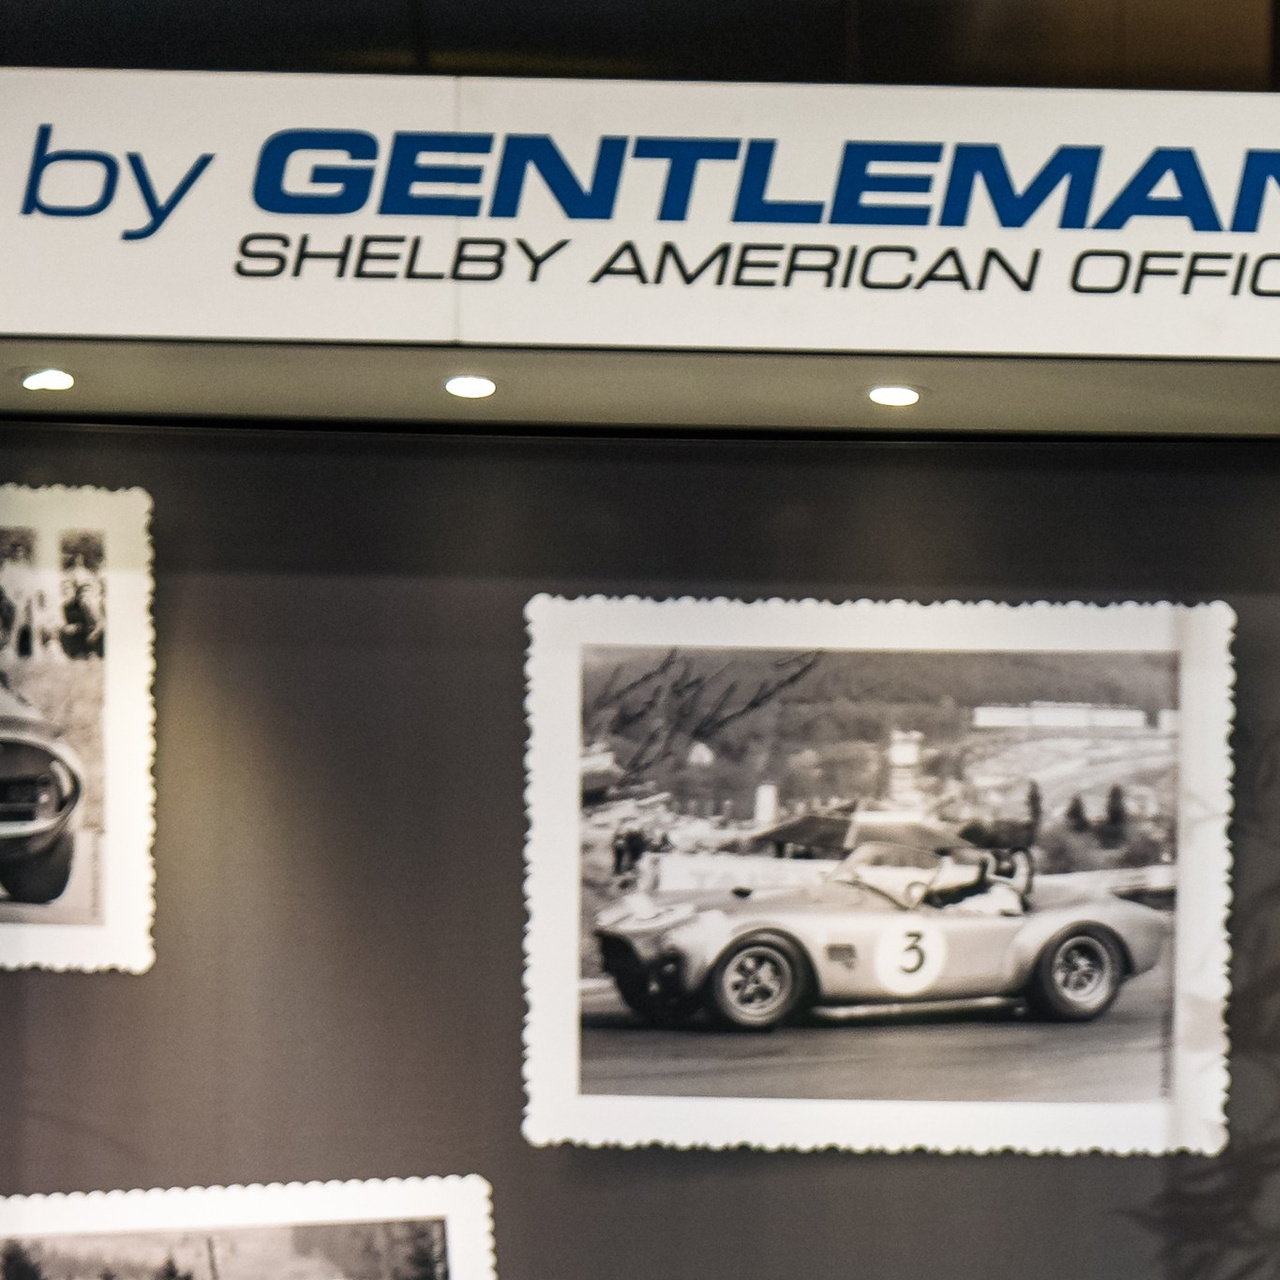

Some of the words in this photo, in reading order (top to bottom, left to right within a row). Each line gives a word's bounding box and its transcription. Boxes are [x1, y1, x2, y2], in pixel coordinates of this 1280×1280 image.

[19, 124, 215, 241] by
[234, 232, 571, 283] SHELBY
[589, 241, 1042, 292] AMERICAN
[899, 930, 926, 974] 3
